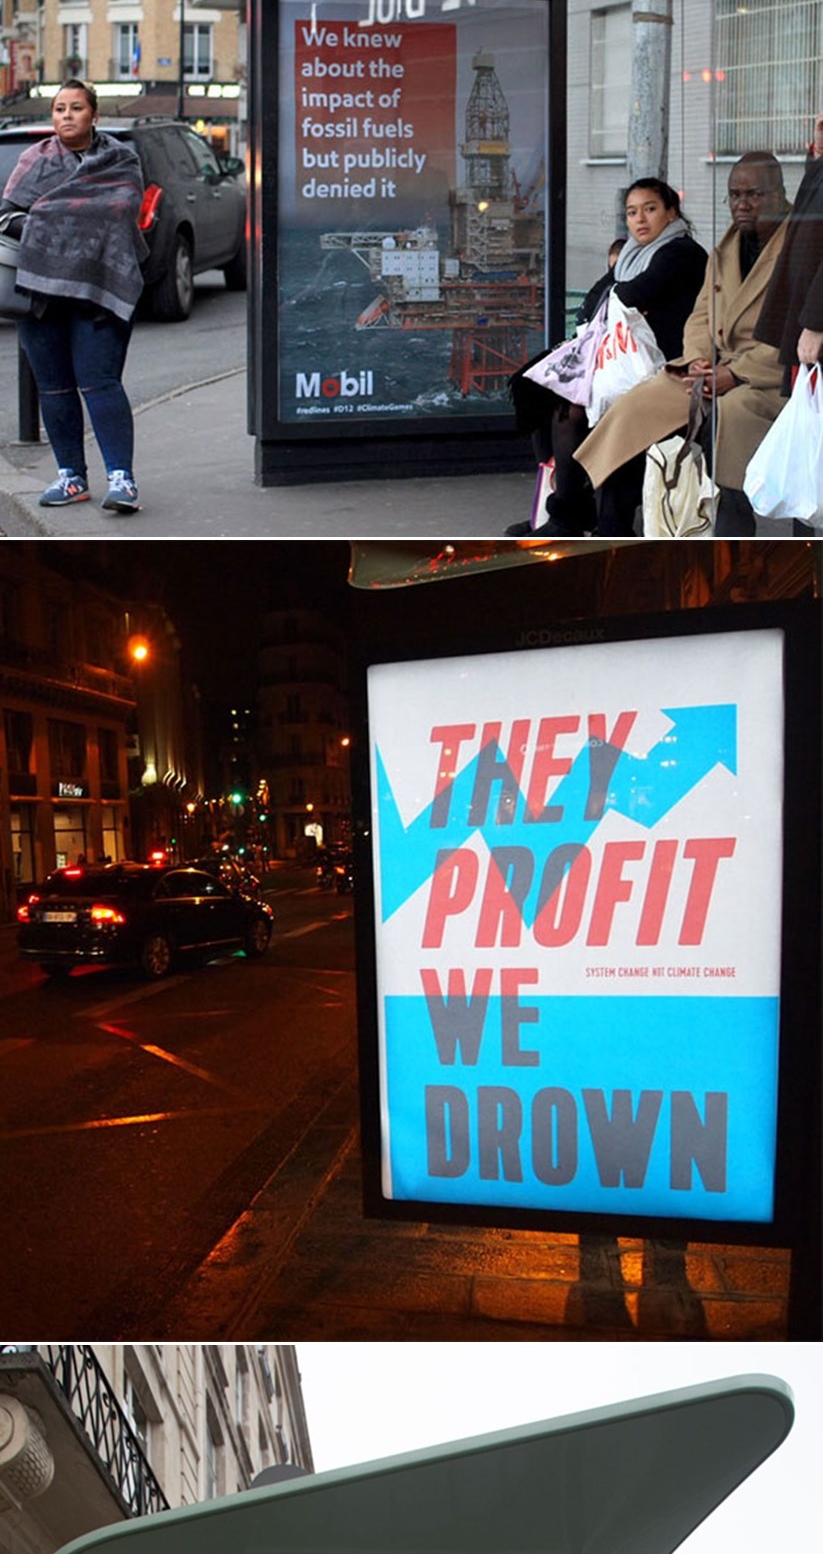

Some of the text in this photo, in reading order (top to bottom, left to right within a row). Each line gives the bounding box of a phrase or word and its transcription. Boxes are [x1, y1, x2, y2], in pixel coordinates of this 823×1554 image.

[302, 26, 403, 48] We knew
[301, 56, 405, 79] about the
[302, 87, 402, 113] impact of
[302, 117, 414, 139] fossil fuels
[302, 148, 427, 174] but publicly
[302, 178, 396, 199] denied it
[296, 370, 374, 398] Mobil
[296, 405, 331, 414] #redlines
[356, 402, 413, 413] #ClimateGames
[516, 628, 605, 645] JCDecaux
[429, 710, 638, 829] THEY
[421, 837, 737, 949] PROFIT
[585, 967, 616, 978] SYSTEM
[618, 966, 649, 978] CHANGE
[667, 966, 700, 978] CLIMATE
[703, 966, 736, 978] CHANGE
[419, 967, 541, 1067] WE
[424, 1084, 728, 1193] DROWN
